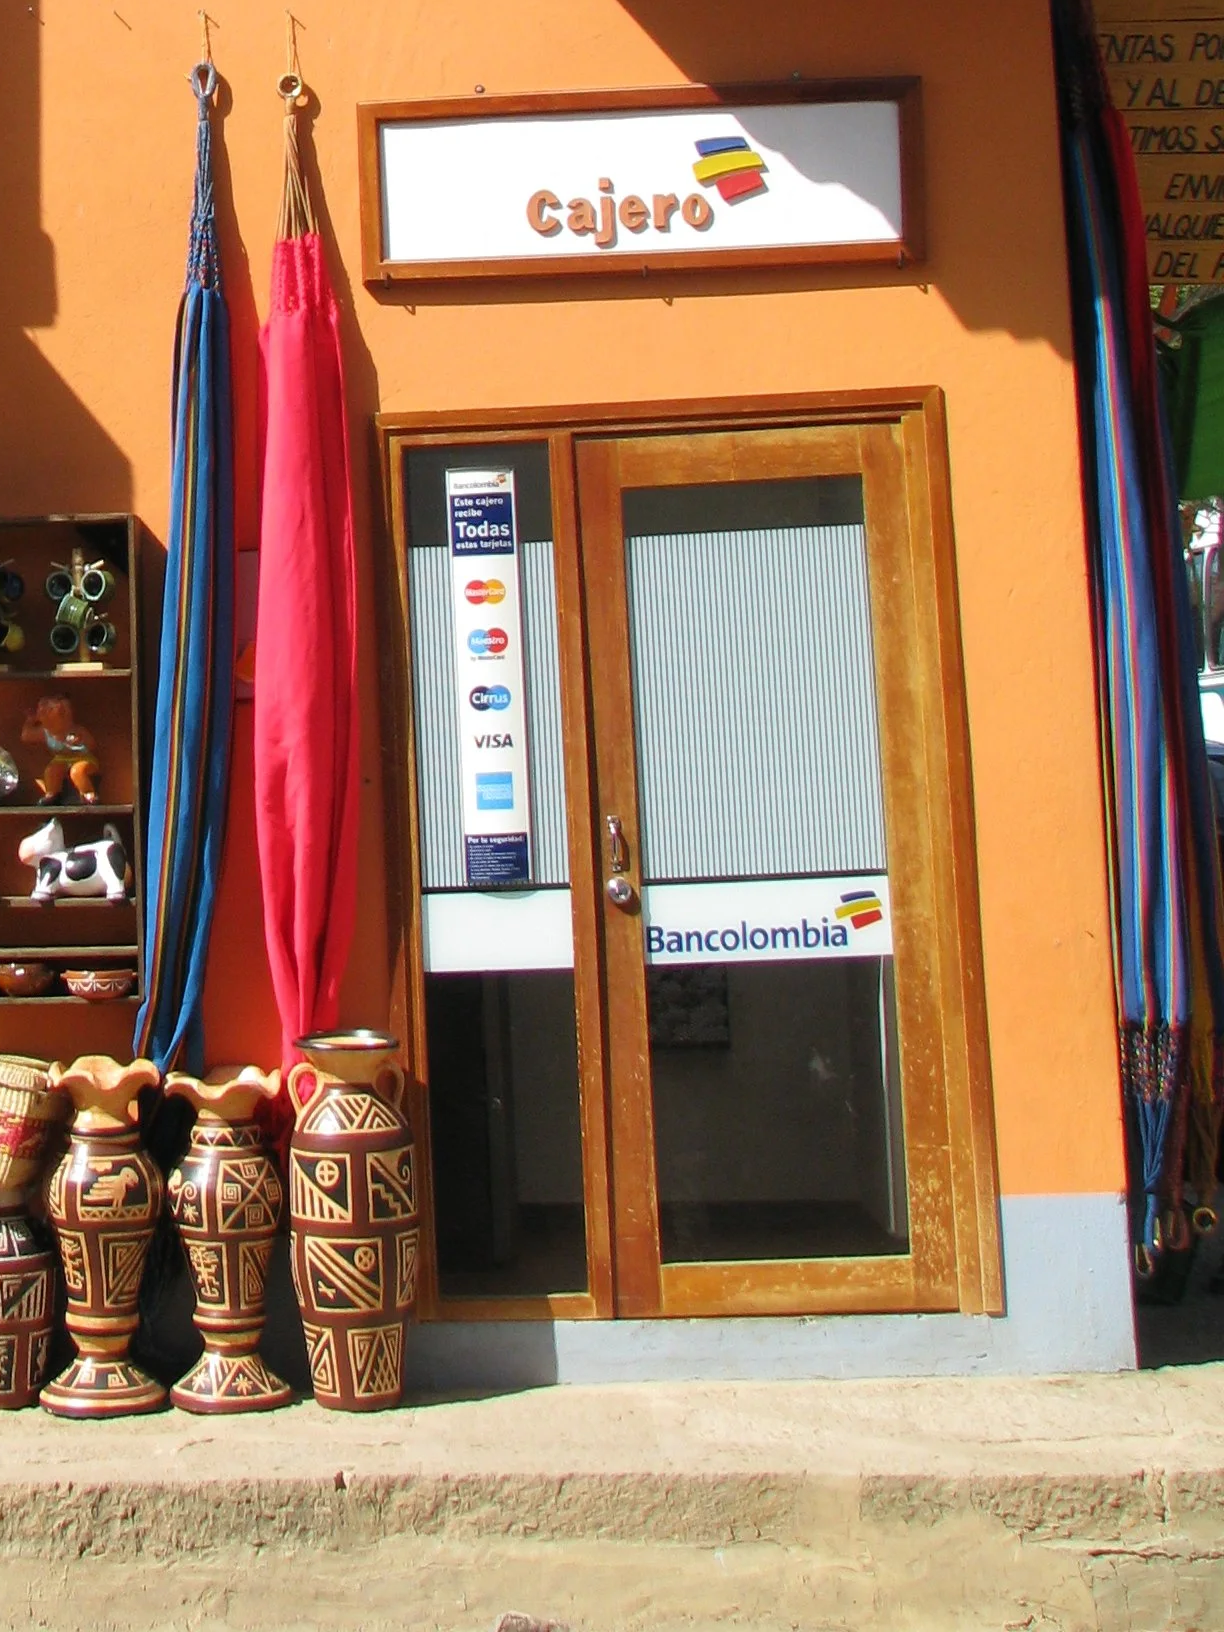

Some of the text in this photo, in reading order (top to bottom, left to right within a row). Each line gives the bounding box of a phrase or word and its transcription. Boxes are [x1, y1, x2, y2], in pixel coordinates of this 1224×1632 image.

[1189, 32, 1224, 62] PO
[1126, 78, 1142, 107] Y
[1146, 78, 1182, 107] AL
[1204, 125, 1224, 151] S
[526, 177, 715, 247] Cajero
[1145, 212, 1224, 241] ALQUIE
[1153, 251, 1199, 278] DEL
[454, 496, 504, 507] Este cajero
[454, 508, 483, 518] recibe
[455, 520, 510, 538] Todas
[455, 539, 512, 550] estas tarjetas
[472, 692, 509, 704] Cirrus
[474, 734, 514, 749] VISA
[646, 917, 848, 953] Bancolombia
